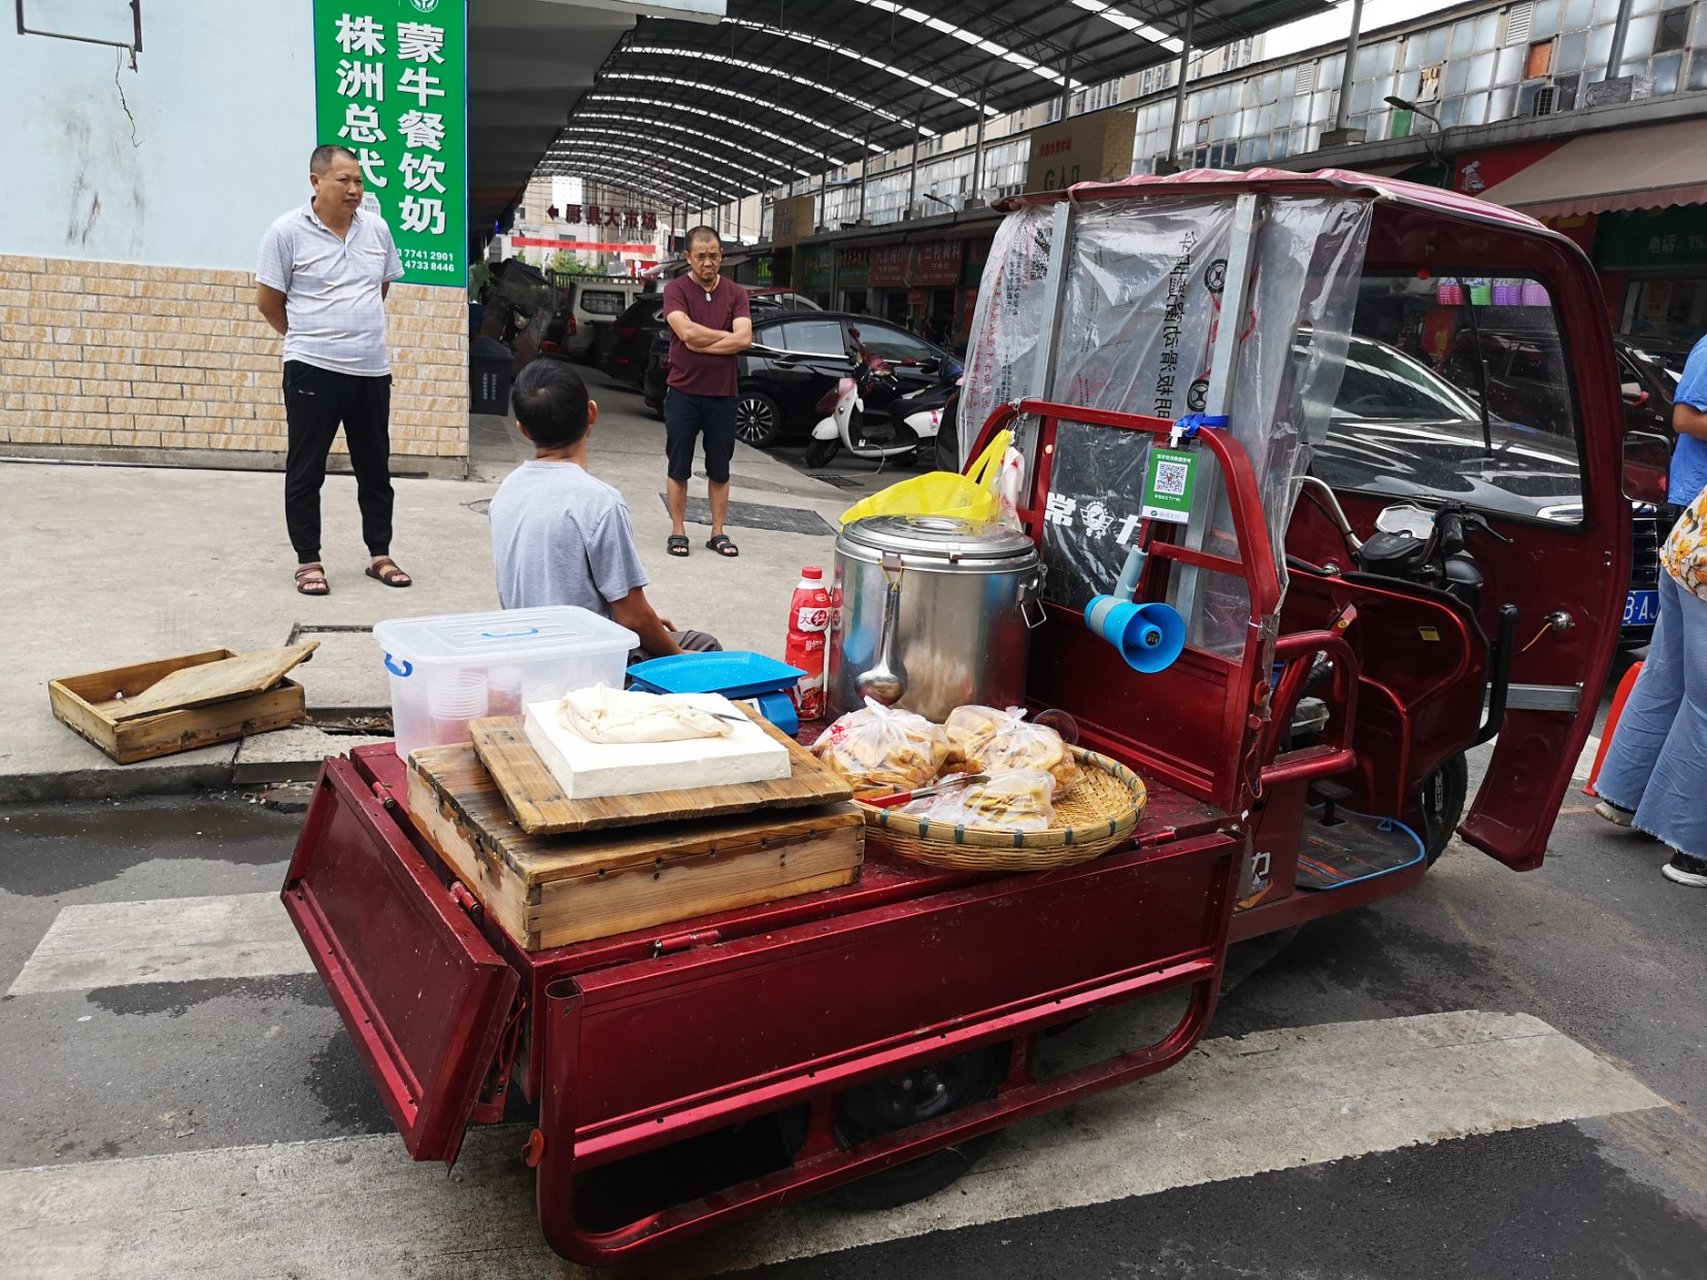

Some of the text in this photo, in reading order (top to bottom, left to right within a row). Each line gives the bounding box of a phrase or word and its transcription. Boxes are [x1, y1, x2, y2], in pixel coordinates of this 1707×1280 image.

[397, 21, 447, 236] 蒙牛餐饮奶
[565, 203, 658, 231] 厨具大市场
[404, 248, 428, 260] 7741
[430, 251, 454, 262] 2901
[405, 259, 455, 273] 4733 8446
